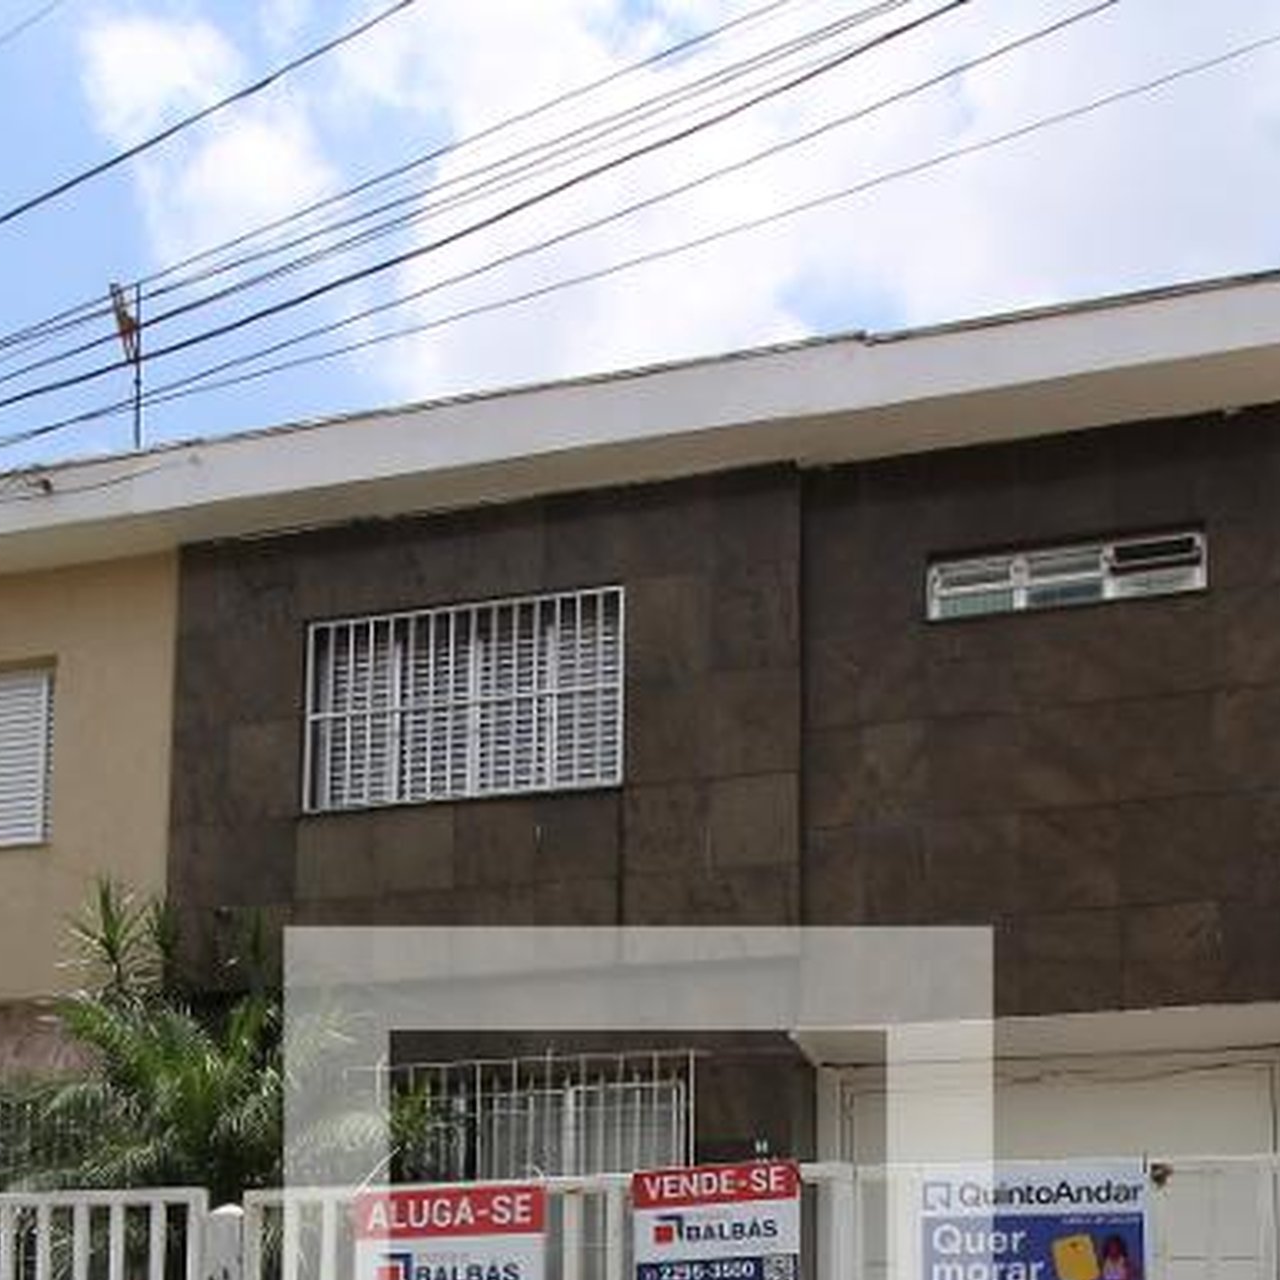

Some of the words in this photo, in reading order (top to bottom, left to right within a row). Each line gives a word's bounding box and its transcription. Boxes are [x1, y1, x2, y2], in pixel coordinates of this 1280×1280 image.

[643, 1166, 788, 1200] VENDE-SE
[959, 1179, 1144, 1208] QuintoAndar
[367, 1193, 533, 1231] ALUGA-SE
[686, 1219, 778, 1241] BALBAS
[932, 1224, 1027, 1255] Quer
